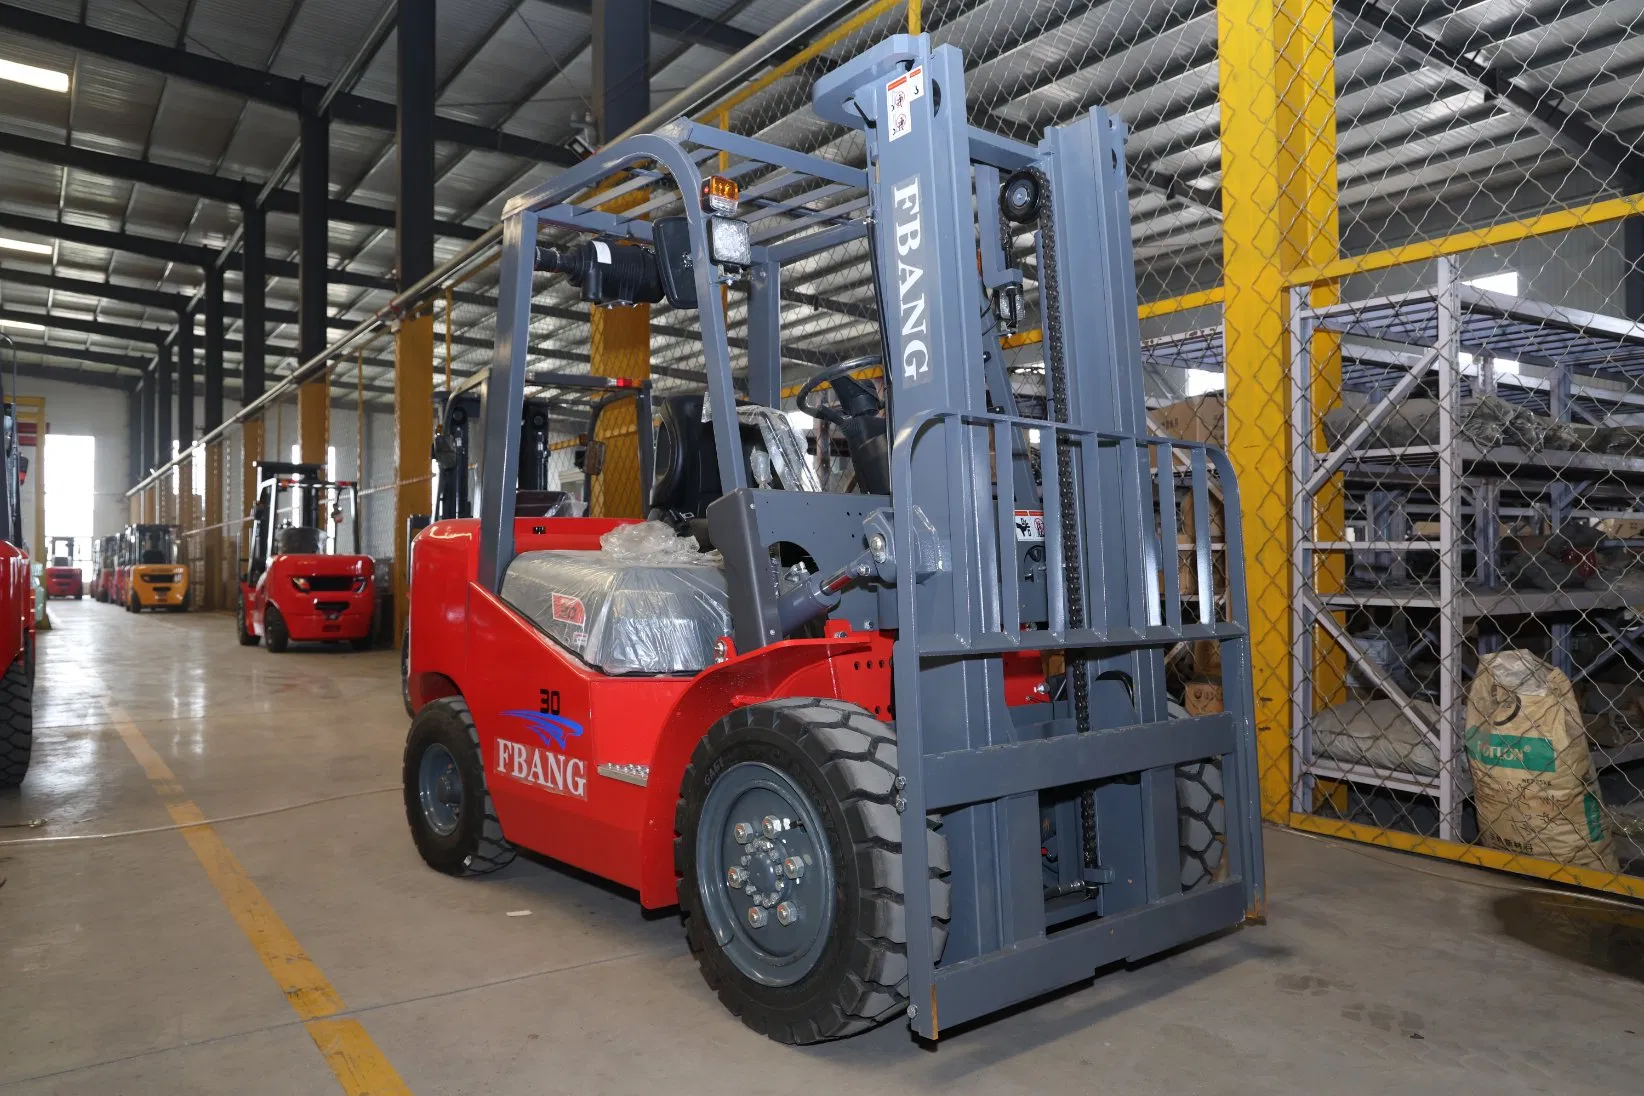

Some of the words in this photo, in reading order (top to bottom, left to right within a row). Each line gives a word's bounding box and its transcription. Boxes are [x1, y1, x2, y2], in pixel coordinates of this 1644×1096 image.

[893, 178, 928, 381] FBANG
[540, 688, 560, 715] 30
[497, 738, 586, 797] FBANG
